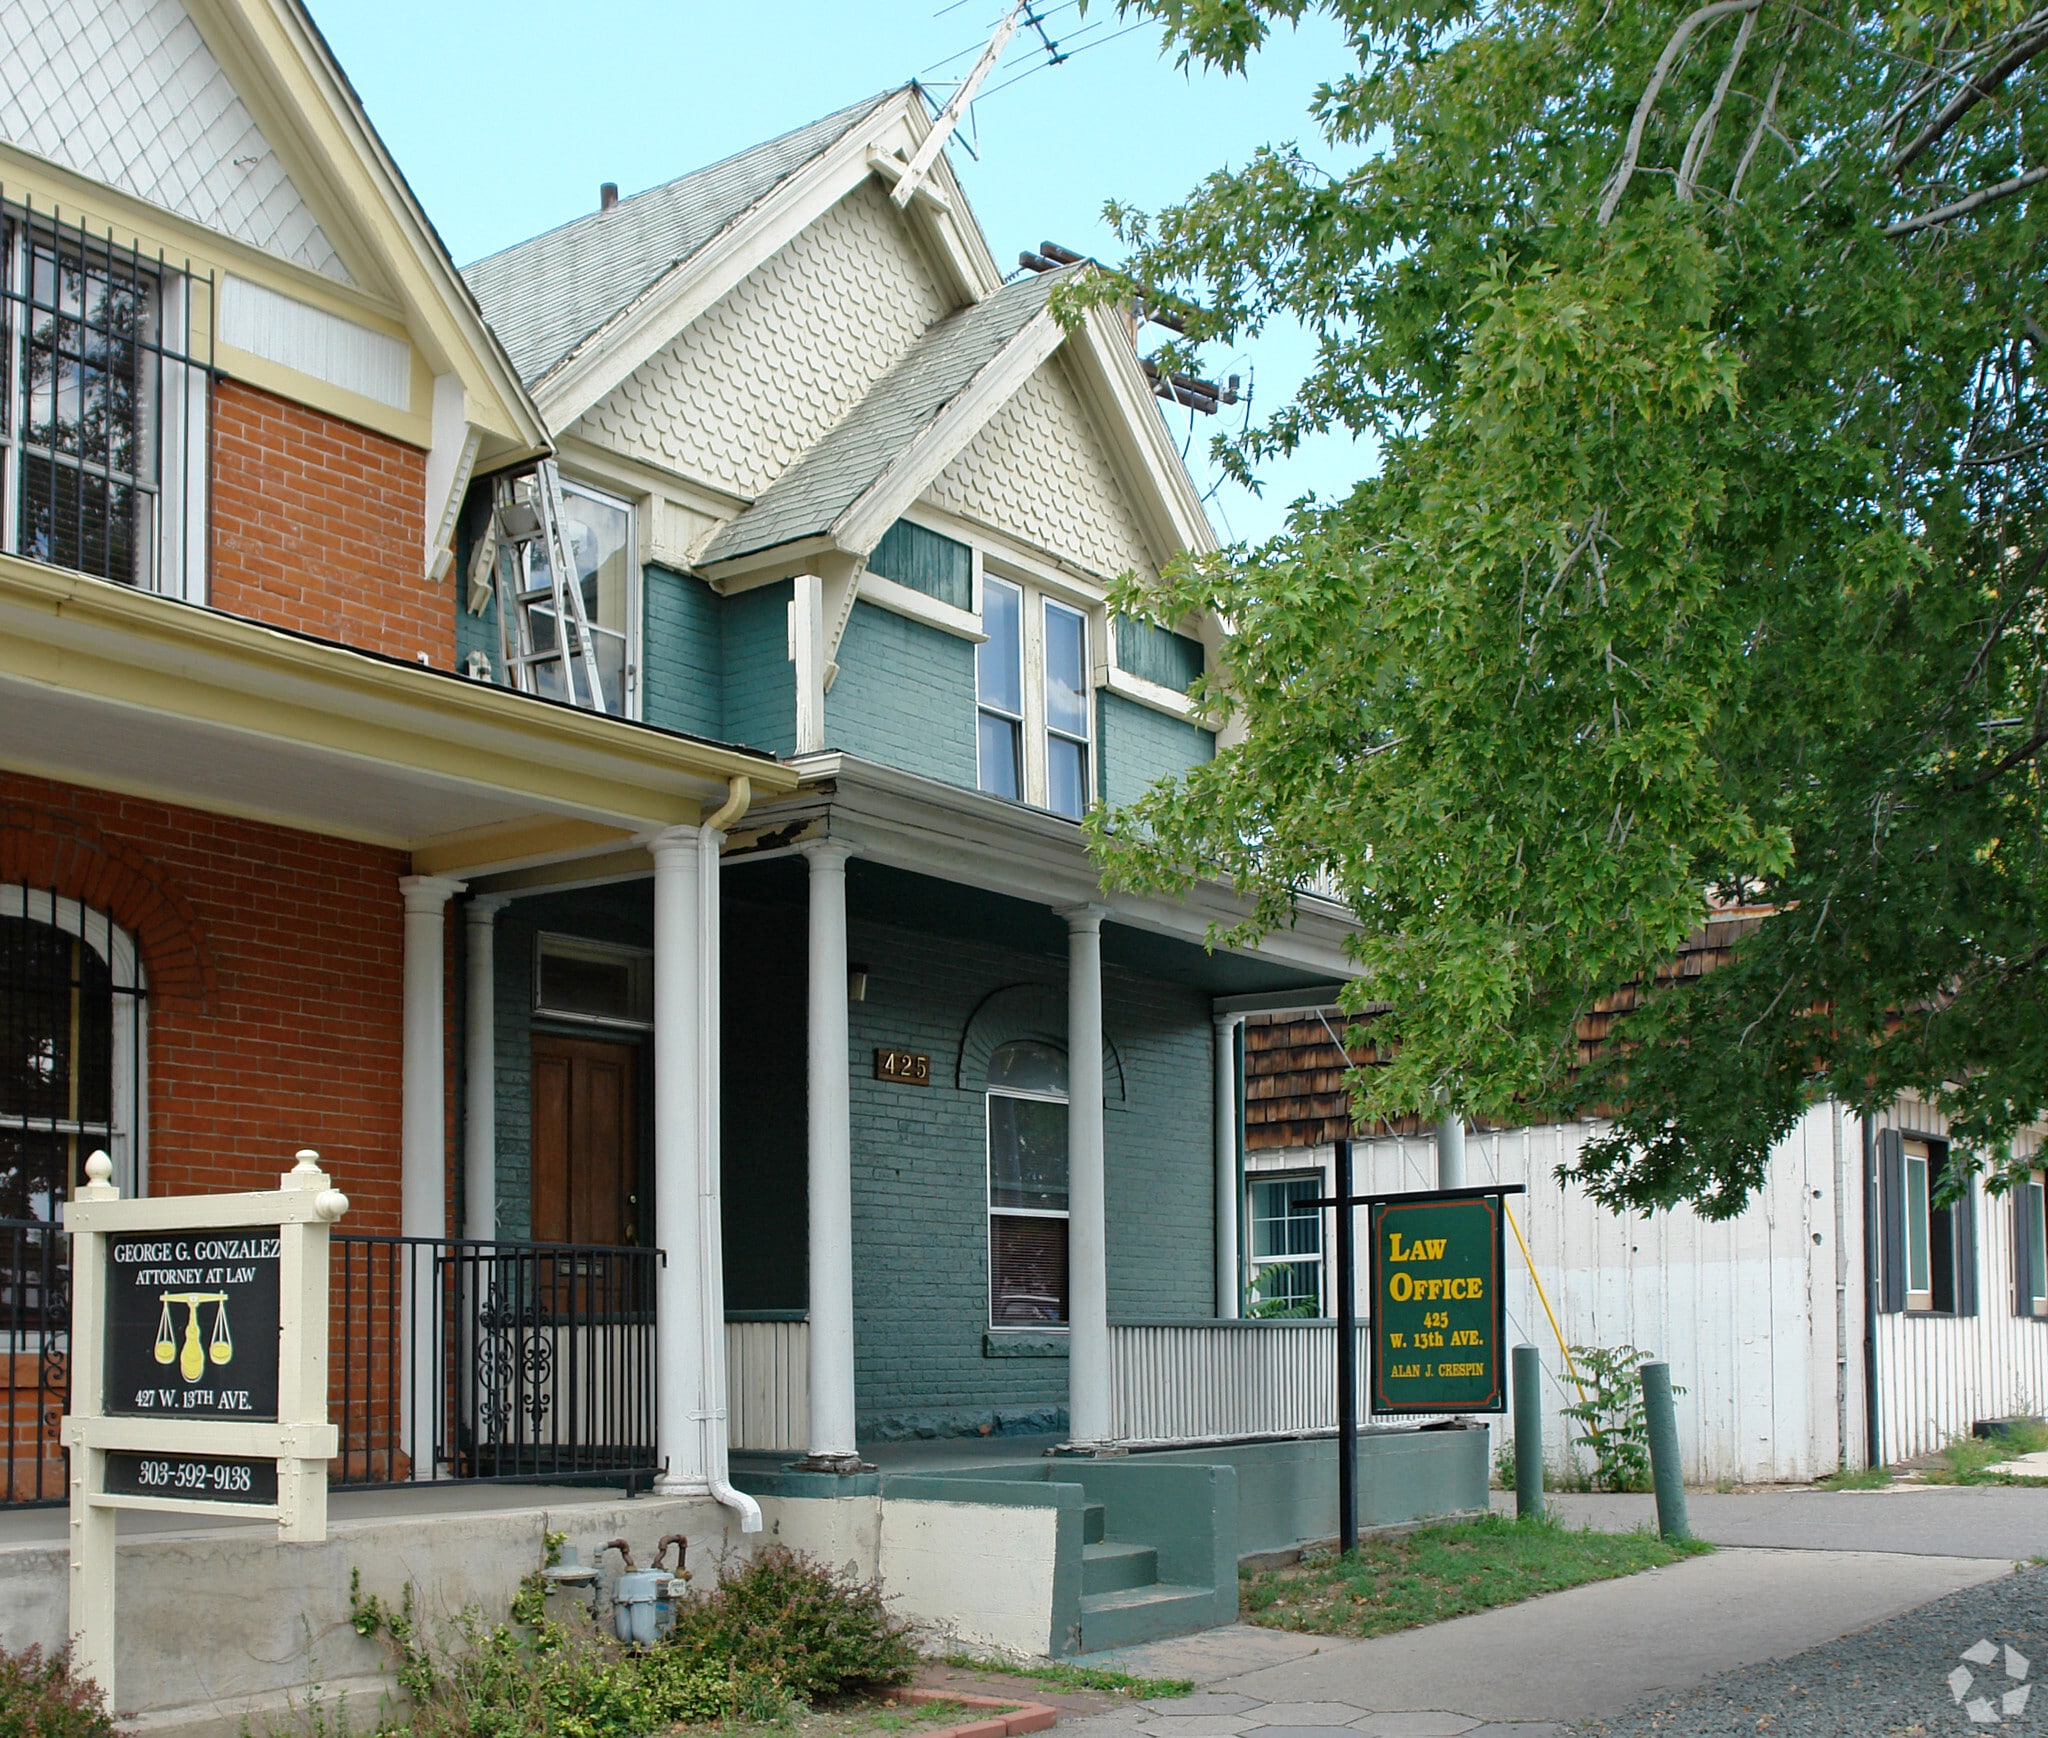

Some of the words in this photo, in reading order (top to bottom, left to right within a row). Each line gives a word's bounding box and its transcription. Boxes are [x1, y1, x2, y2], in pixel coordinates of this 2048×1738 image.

[885, 1053, 926, 1078] 425
[114, 1242, 171, 1262] GEORGE
[175, 1242, 191, 1261] G.
[194, 1239, 280, 1259] GONZALEZ
[135, 1268, 203, 1285] ATTORNEY
[205, 1267, 224, 1283] AT
[226, 1267, 256, 1283] LAW
[1423, 1311, 1449, 1328] 425
[1390, 1333, 1407, 1348] W.
[1413, 1332, 1444, 1349] 13th
[1450, 1330, 1484, 1346] AVE.
[1391, 1364, 1420, 1378] ALAN
[1425, 1364, 1434, 1377] J.
[1438, 1362, 1484, 1377] CRESPIN
[135, 1390, 155, 1407] 427
[158, 1389, 178, 1408] W.
[183, 1390, 213, 1408] 13TH
[217, 1391, 252, 1410] AVE.
[138, 1461, 251, 1491] 303-592-9138
